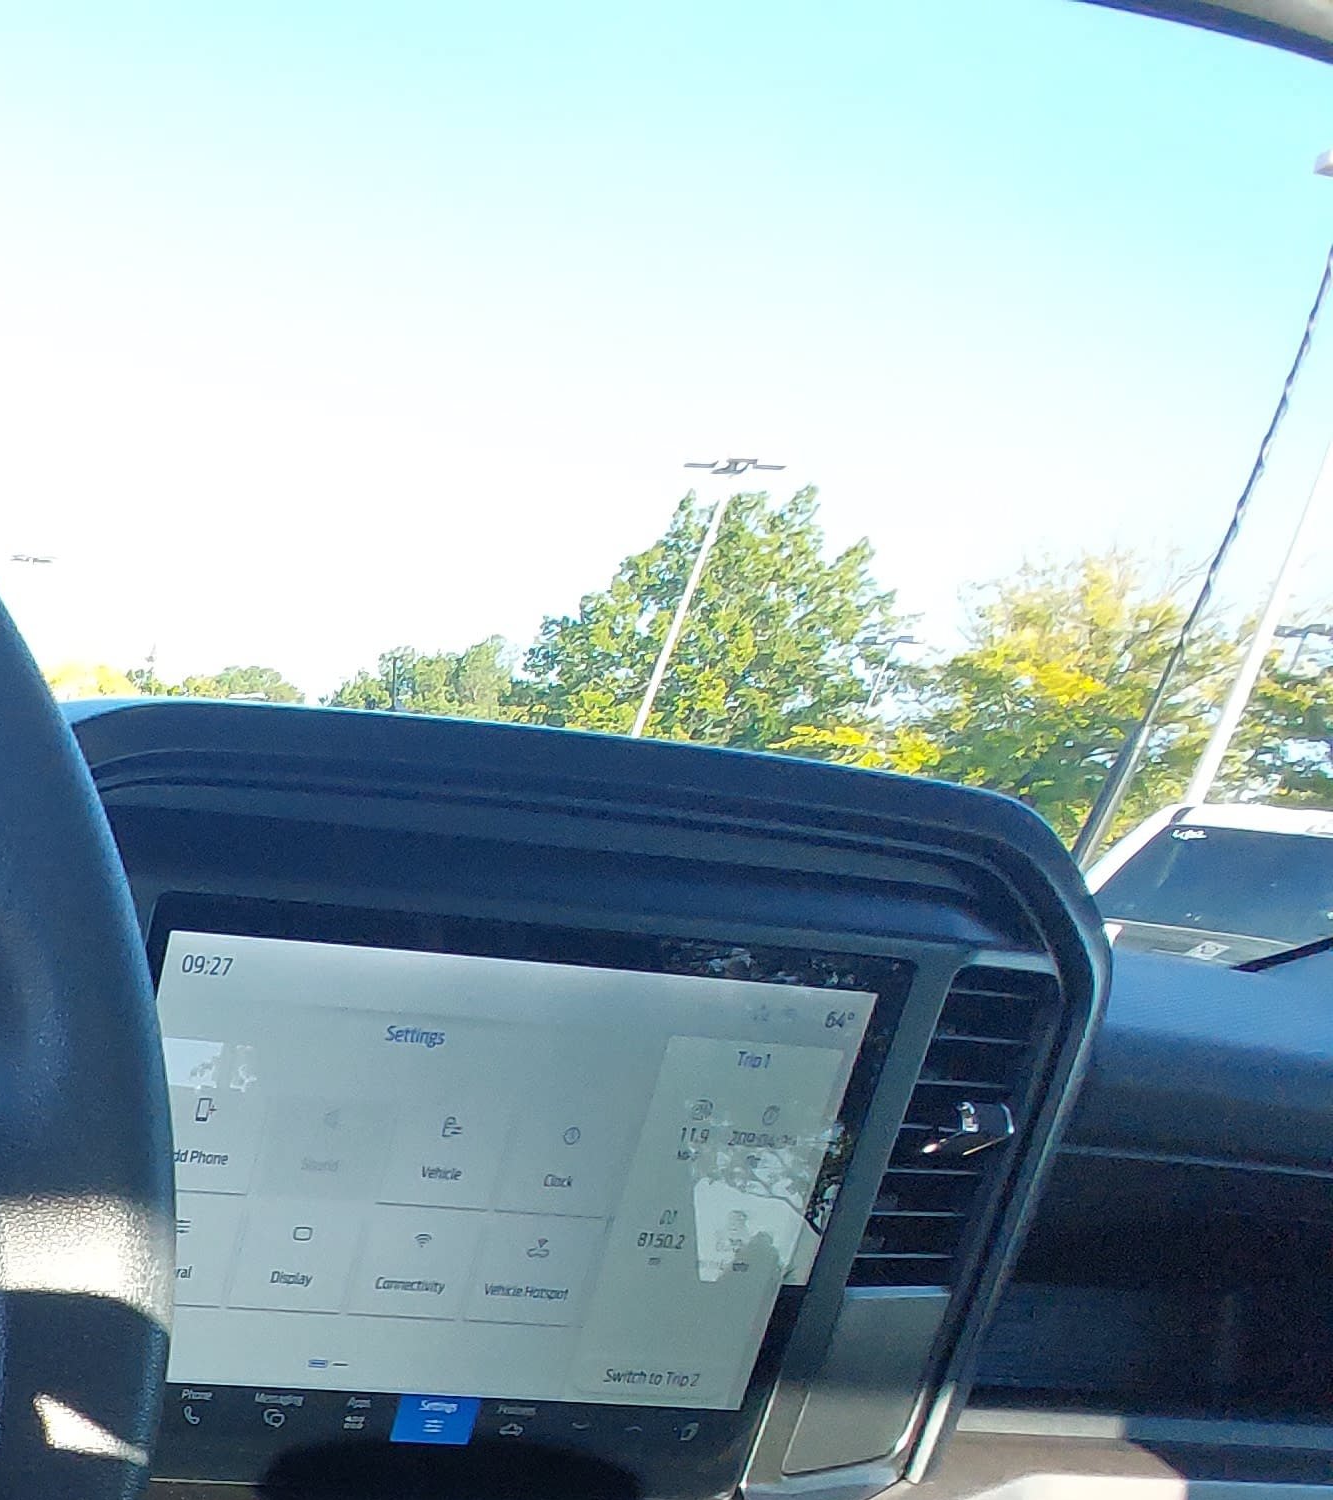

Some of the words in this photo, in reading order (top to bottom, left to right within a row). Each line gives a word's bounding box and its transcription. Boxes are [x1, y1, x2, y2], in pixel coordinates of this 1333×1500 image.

[181, 954, 234, 977] 09:27
[385, 1025, 446, 1049] Settings
[737, 1051, 763, 1069] Trip
[681, 1127, 711, 1145] 11.9
[172, 1149, 189, 1163] dd
[189, 1150, 229, 1167] Phone
[421, 1165, 463, 1182] Vehicle
[543, 1174, 573, 1188] Clock
[270, 1270, 314, 1288] Display
[375, 1276, 446, 1296] Connectivity
[484, 1283, 524, 1298] Vehicle
[525, 1284, 570, 1301] Hotspot
[603, 1367, 647, 1385] Switch
[648, 1371, 662, 1386] to
[666, 1371, 690, 1387] Trip
[690, 1373, 700, 1388] 2
[181, 1388, 214, 1402] Phone
[417, 1400, 459, 1415] Settings
